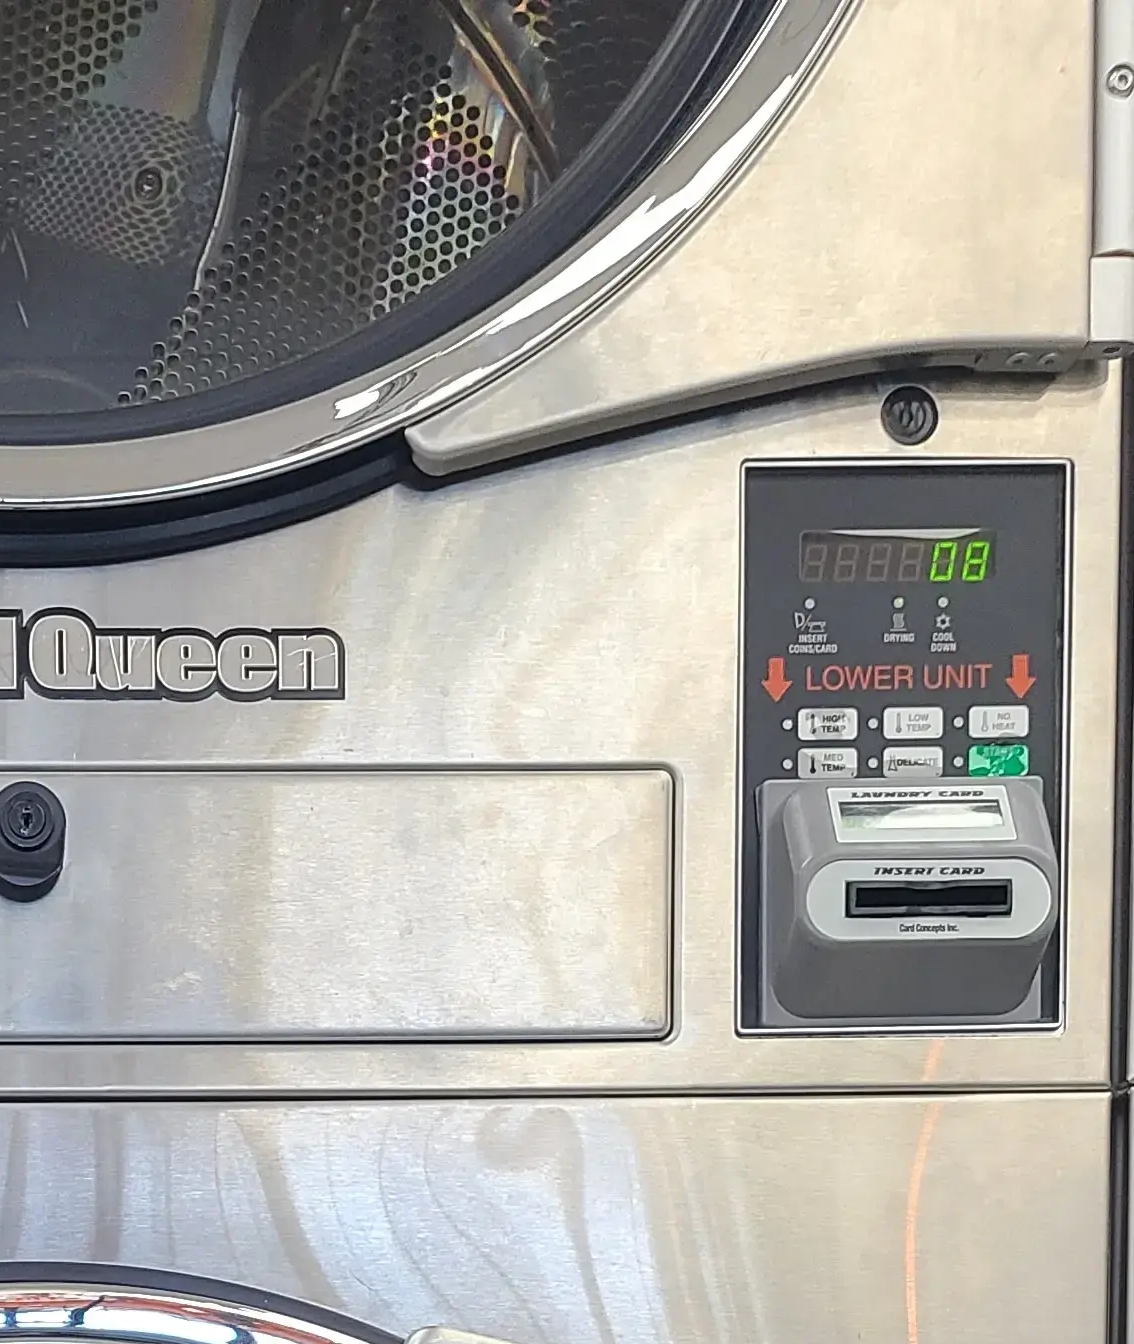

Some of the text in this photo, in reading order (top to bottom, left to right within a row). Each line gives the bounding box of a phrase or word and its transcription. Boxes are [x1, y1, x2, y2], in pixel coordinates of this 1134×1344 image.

[929, 541, 990, 582] 08
[798, 633, 828, 643] INSERT
[883, 633, 915, 643] DRYING
[932, 632, 955, 642] COOL
[788, 643, 838, 654] COINS/CARD
[930, 642, 957, 652] DOWN
[25, 606, 347, 702] Queen
[805, 663, 993, 692] LOWER UNIT
[908, 713, 930, 722] LOW
[996, 712, 1011, 721] NO
[821, 725, 847, 734] TEMP
[906, 723, 932, 733] TEMP
[991, 722, 1017, 731] HEAT
[823, 753, 844, 761] MED
[820, 763, 846, 772] TEMP
[850, 790, 984, 799] LAUNDRY CARD
[873, 866, 986, 876] INSERT CARD
[899, 923, 960, 935] Card Concepts Inc.
